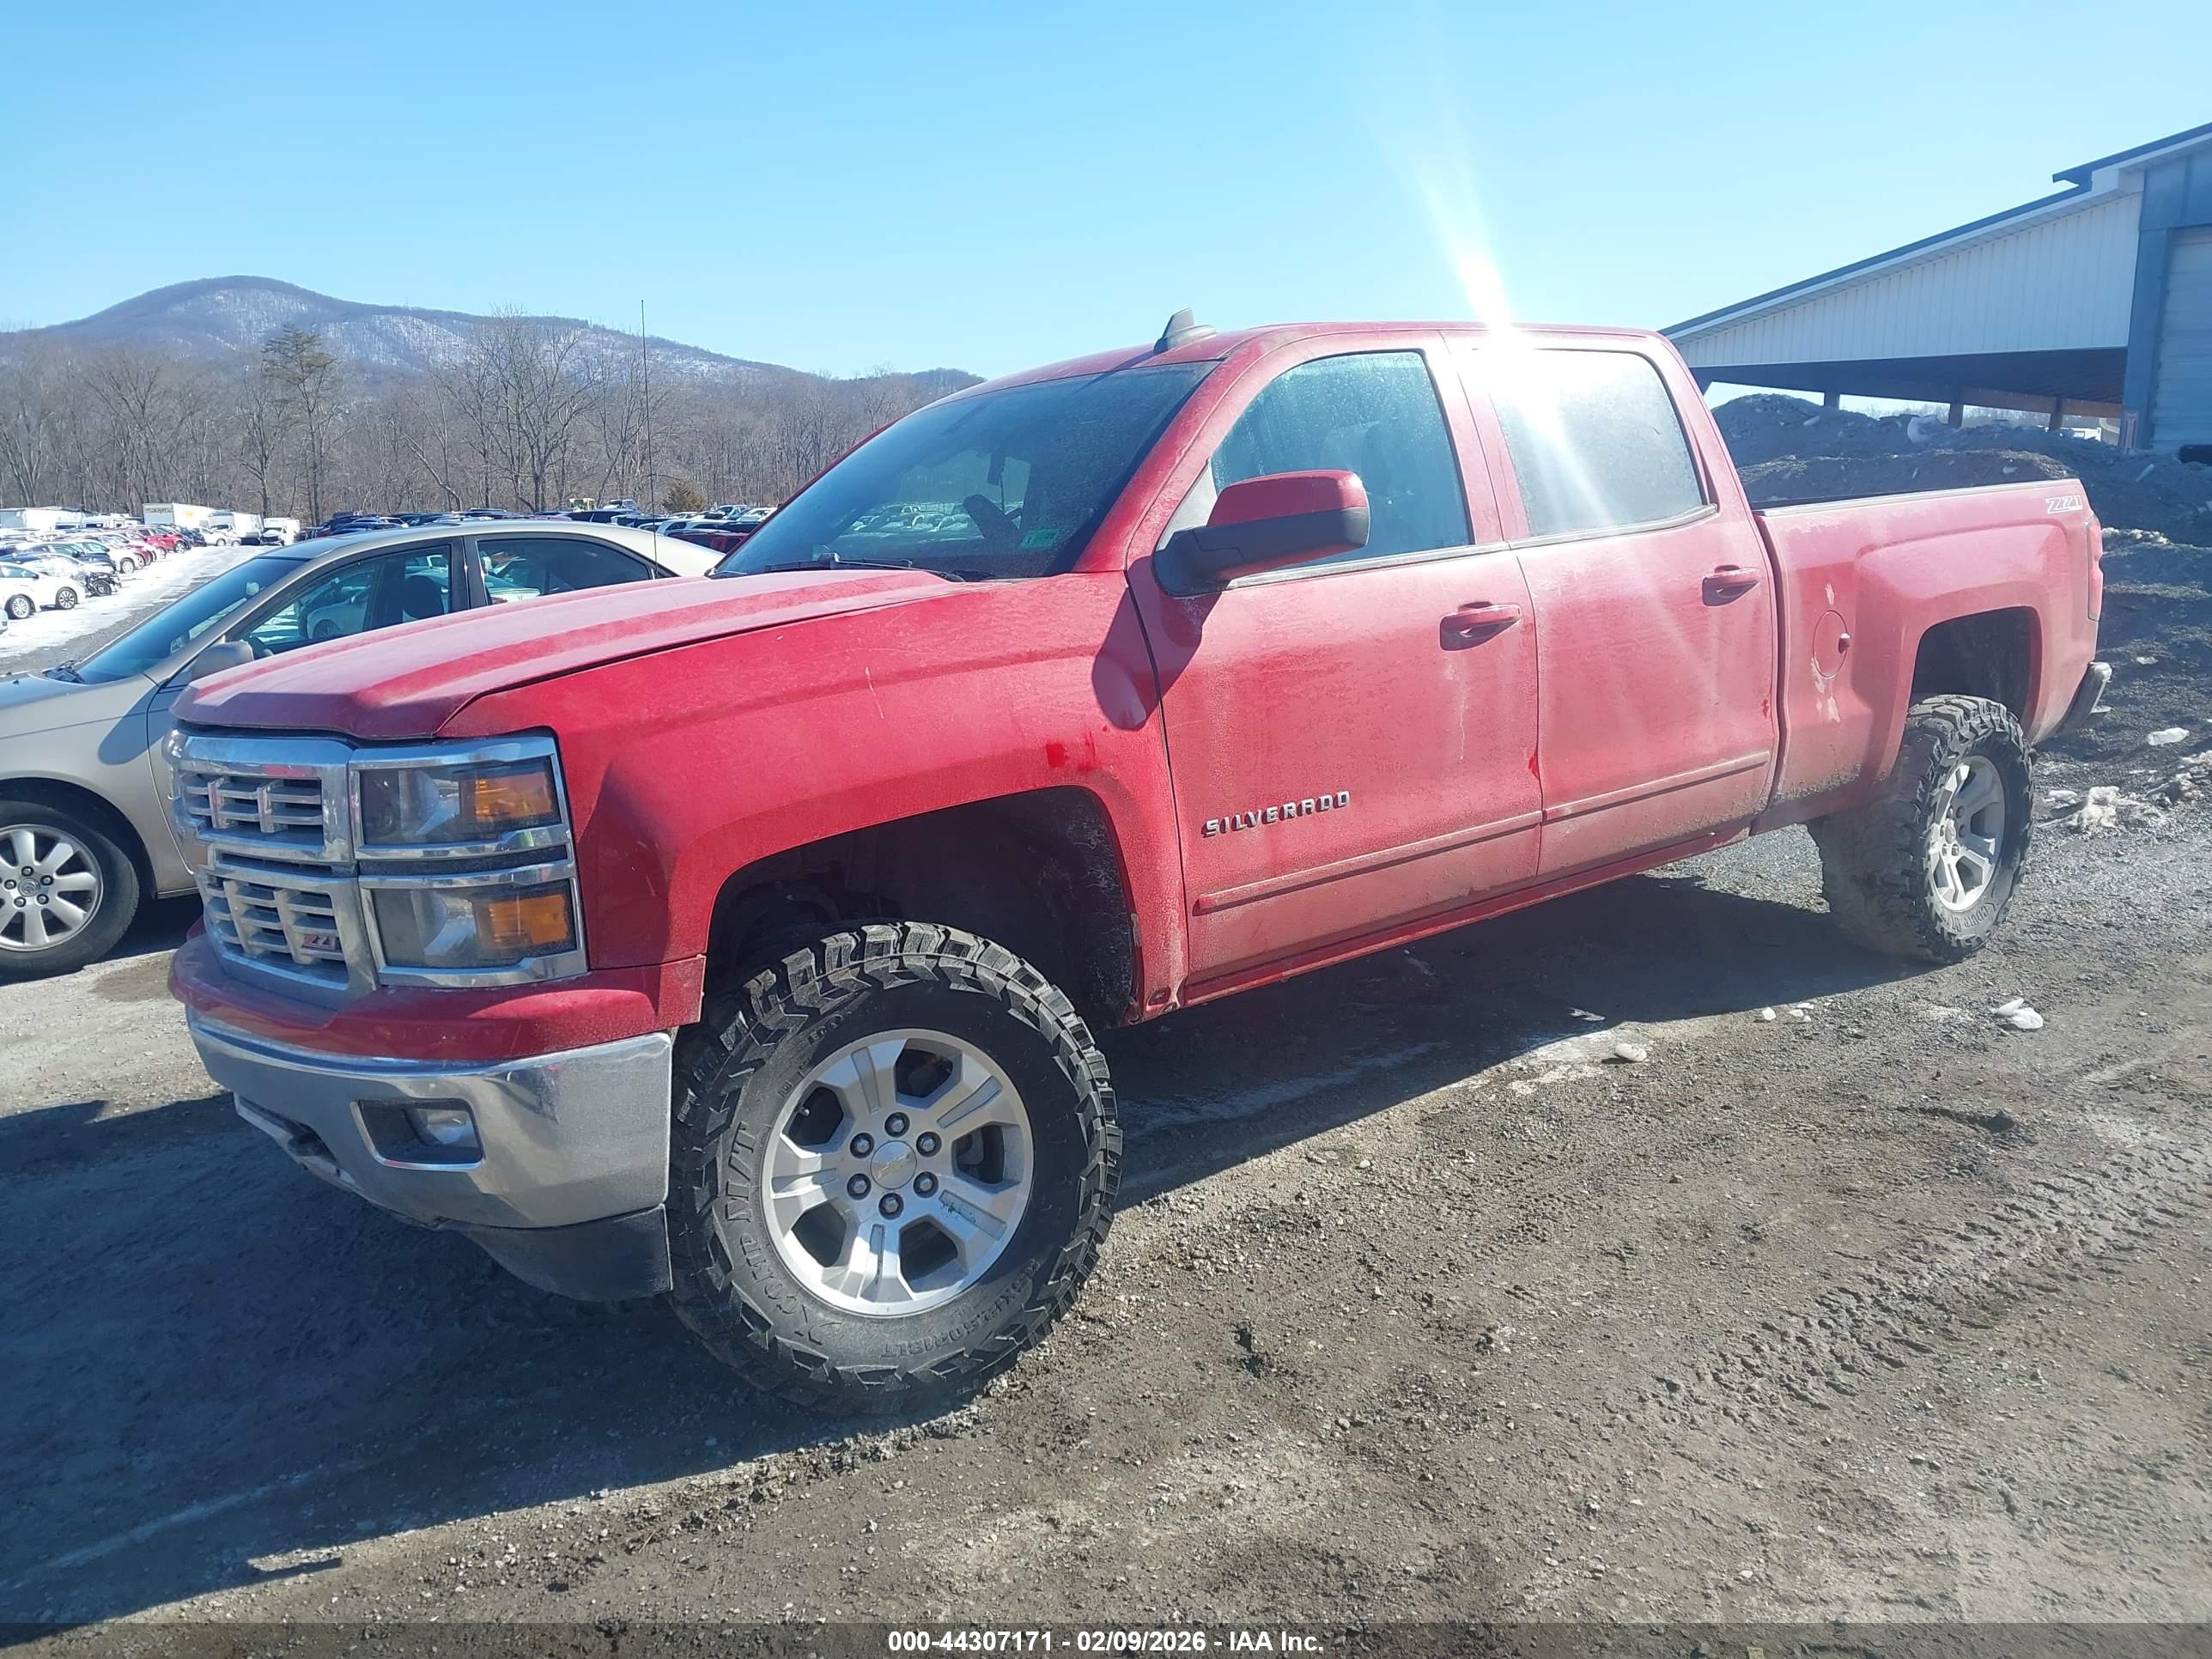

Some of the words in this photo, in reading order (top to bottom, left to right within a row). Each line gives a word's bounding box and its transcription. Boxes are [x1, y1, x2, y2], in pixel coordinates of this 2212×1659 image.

[2045, 495, 2084, 514] Z71
[1202, 789, 1351, 838] SILVERADO
[725, 1121, 757, 1223] M/T
